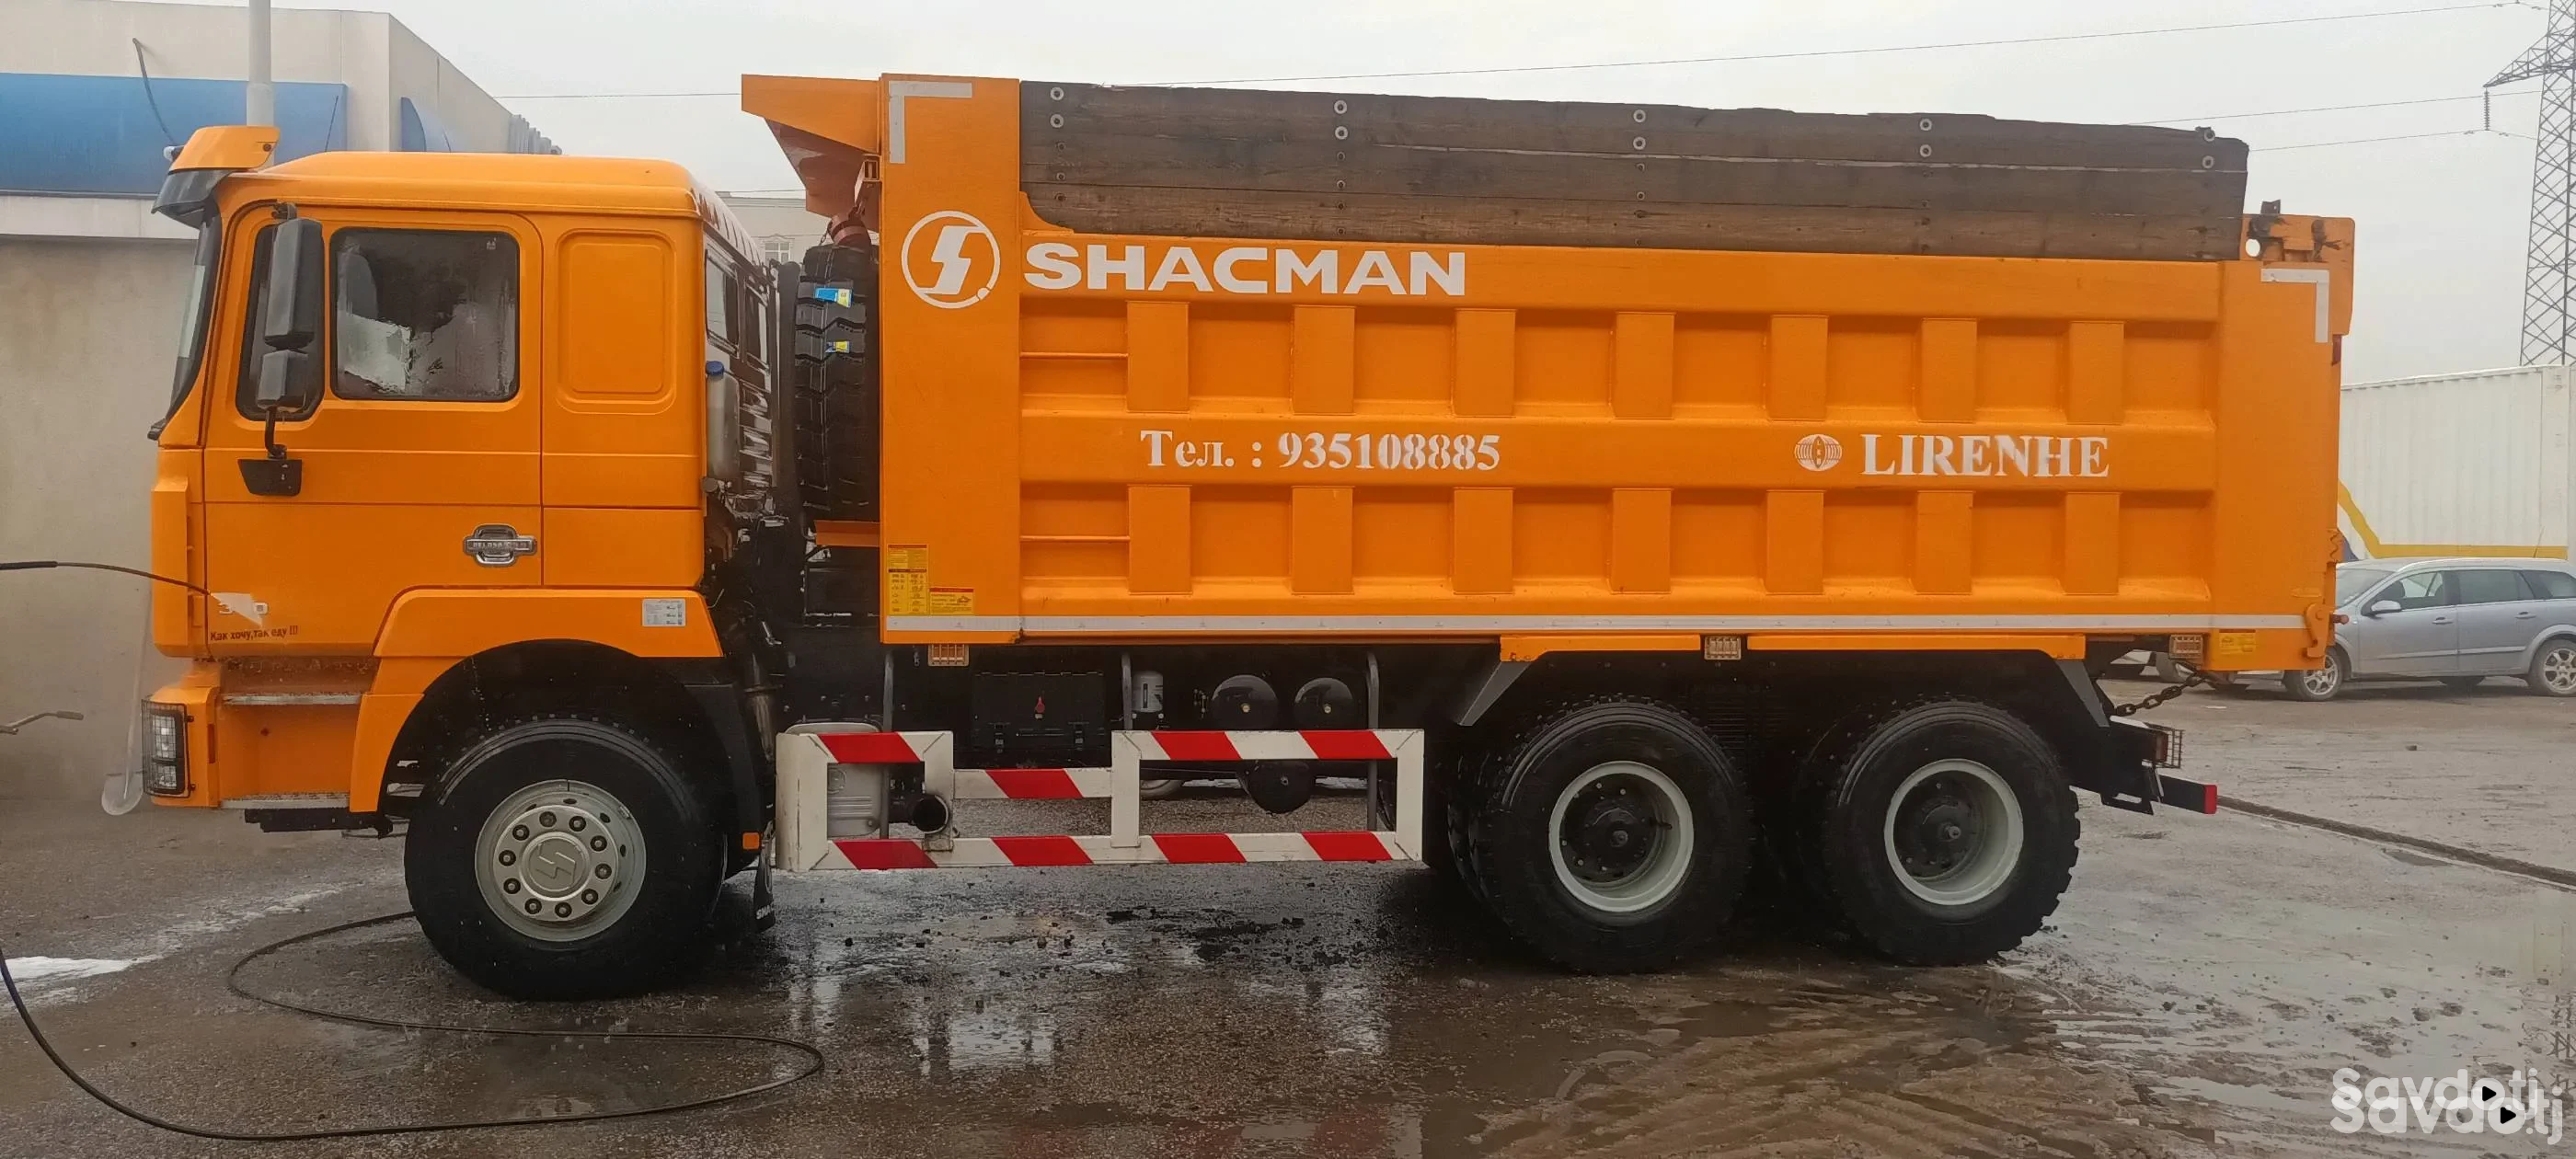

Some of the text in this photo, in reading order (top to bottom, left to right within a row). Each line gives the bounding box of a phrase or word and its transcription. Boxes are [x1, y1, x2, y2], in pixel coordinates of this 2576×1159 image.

[1024, 243, 1466, 296] SHACMAN
[1140, 430, 1235, 467] Тел.
[1278, 432, 1501, 471] 935108885
[1860, 433, 2110, 477] LIRENHE
[218, 602, 269, 615] 30
[210, 631, 229, 641] Как
[271, 627, 288, 638] еду
